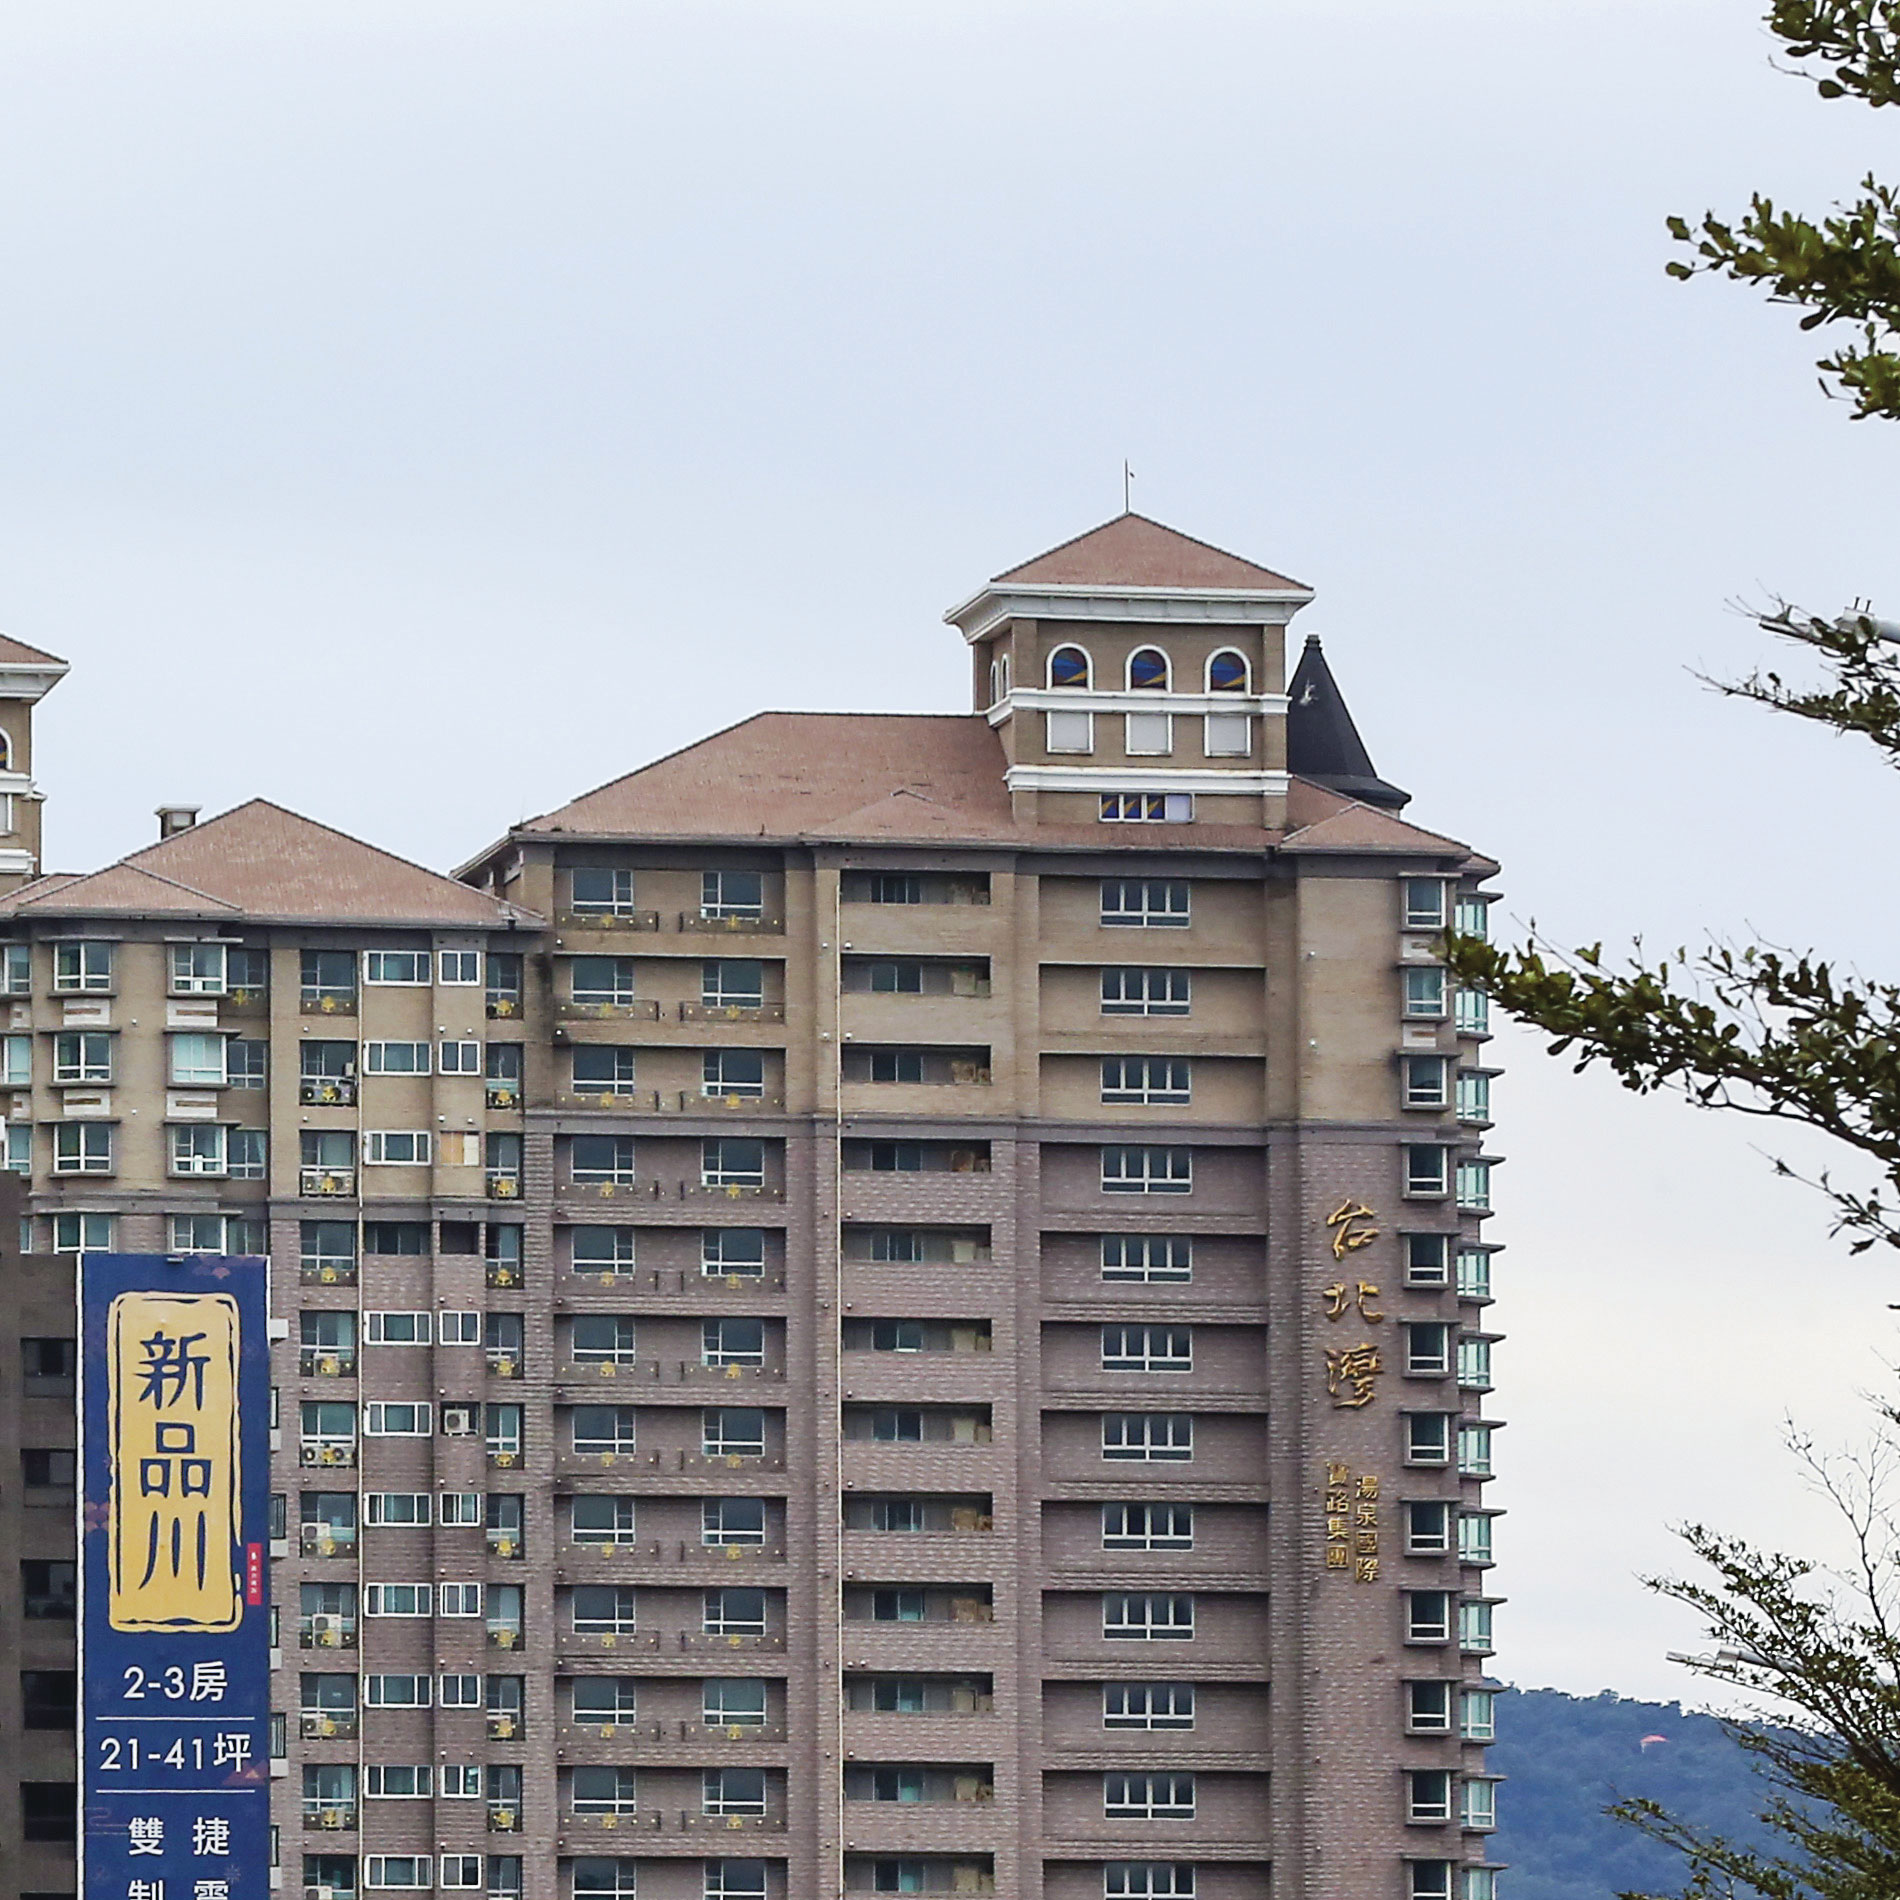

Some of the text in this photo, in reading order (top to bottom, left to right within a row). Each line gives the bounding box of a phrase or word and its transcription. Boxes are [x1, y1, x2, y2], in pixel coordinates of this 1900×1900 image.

[1323, 1199, 1384, 1410] 台北灣
[137, 1330, 214, 1591] 新品川
[1355, 1474, 1380, 1583] 湯泉國際
[123, 1660, 228, 1702] 2-3房
[100, 1732, 252, 1773] 21-41坪
[128, 1816, 231, 1857] 雙捷
